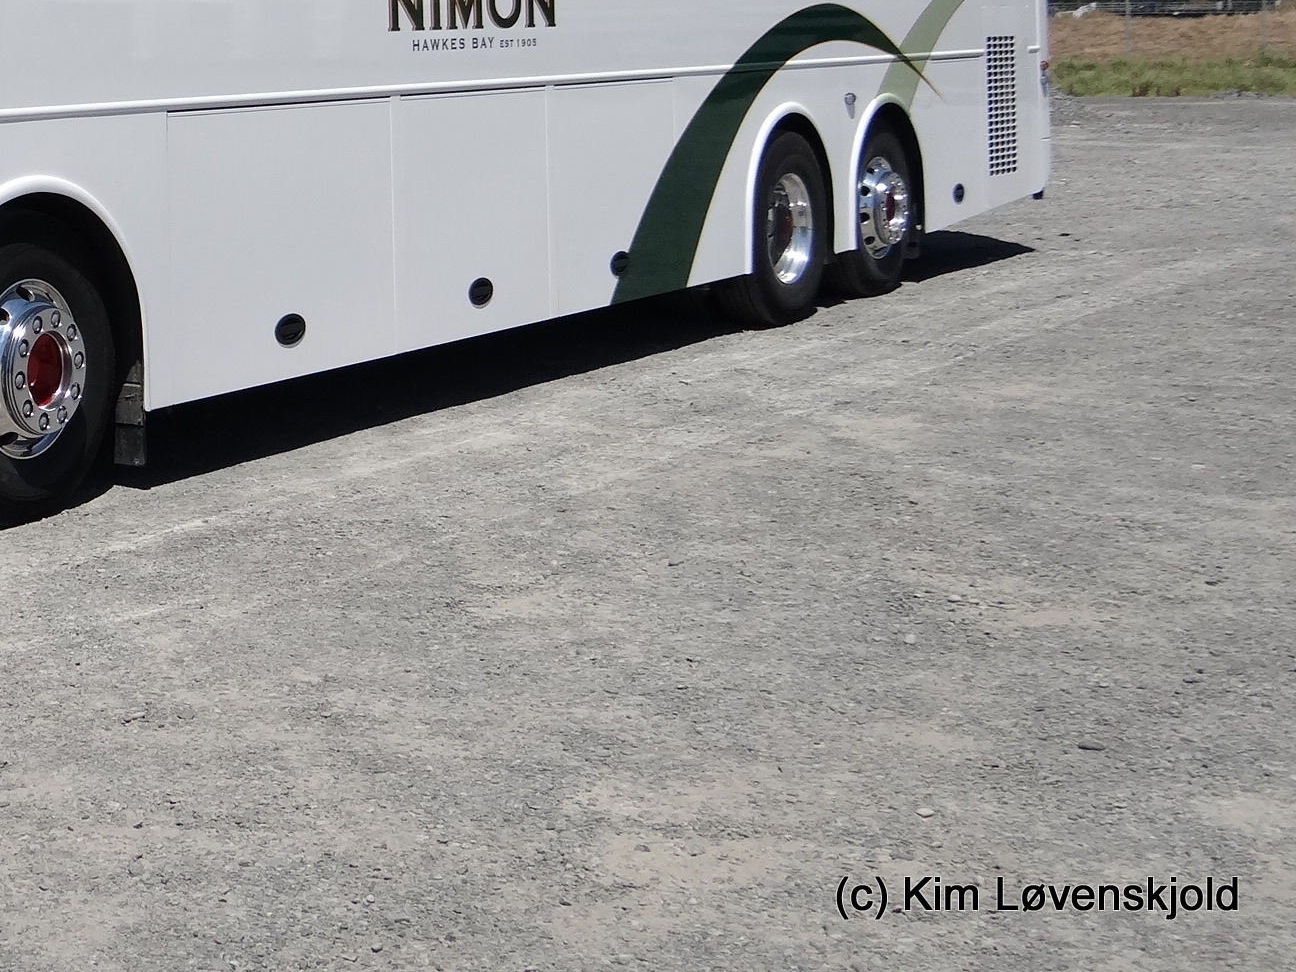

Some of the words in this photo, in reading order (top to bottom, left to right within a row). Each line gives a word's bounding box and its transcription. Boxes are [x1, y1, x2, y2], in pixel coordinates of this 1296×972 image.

[412, 37, 466, 52] HAWKES
[472, 36, 495, 49] BAY
[499, 39, 514, 48] EST
[516, 38, 537, 47] 1905
